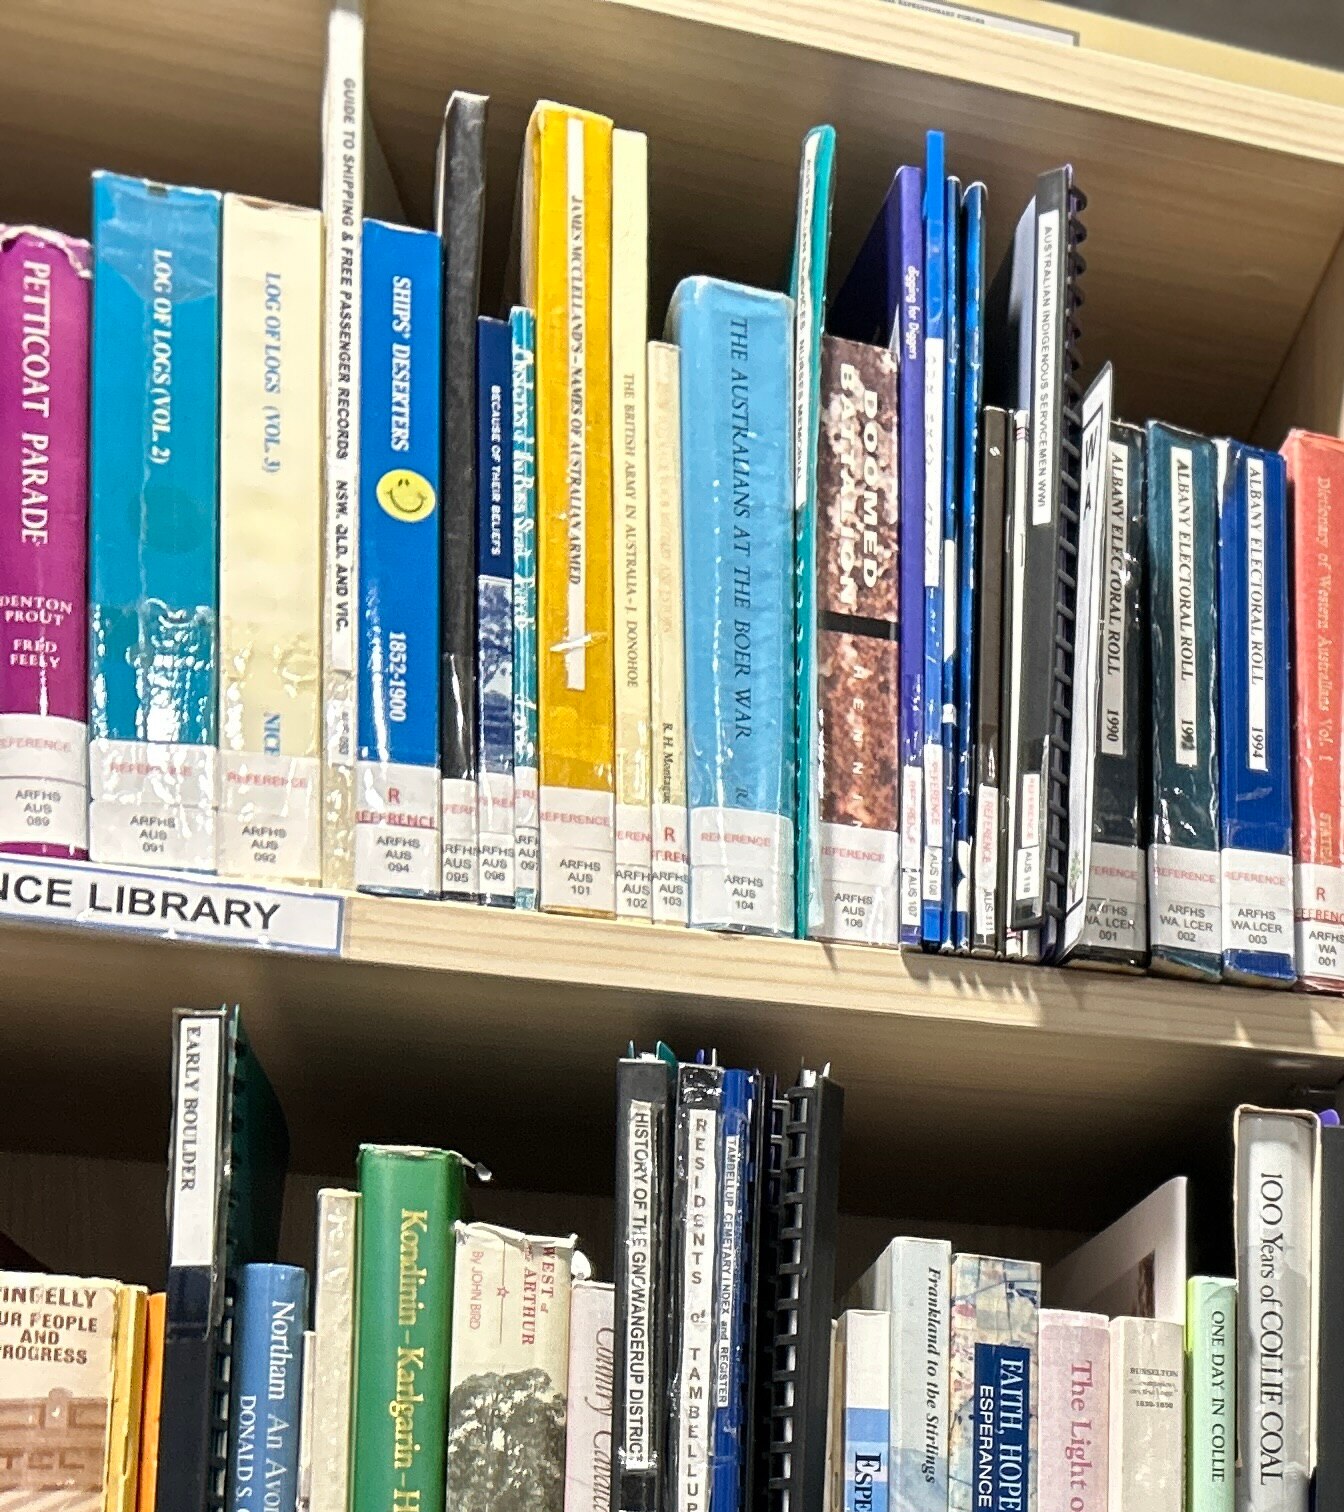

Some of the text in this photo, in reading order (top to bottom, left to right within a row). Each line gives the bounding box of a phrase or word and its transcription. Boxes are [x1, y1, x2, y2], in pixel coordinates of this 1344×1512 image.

[343, 78, 356, 122] GUIDE
[343, 129, 355, 150] TO
[342, 154, 355, 227] SHIPPING
[341, 248, 353, 285] FREE
[342, 232, 353, 244] &
[1042, 225, 1052, 308] AUSTRALIAN
[150, 249, 172, 465] LOG OF LOGS (VOL. 2)
[339, 291, 353, 380] PASSENGER
[1040, 311, 1051, 389] INDIGENOUS
[20, 259, 51, 544] PETTICOAT PARADE
[261, 272, 281, 474] LOG OF LOGS (VOL. 3)
[390, 344, 410, 453] DESERTERS
[337, 383, 350, 460] RECORDS
[1038, 393, 1049, 476] SERVICEMEN
[335, 481, 348, 519] NSW.
[730, 319, 752, 738] THE AUSTRALIANS AT THE BOER WAR
[335, 571, 348, 600] AND
[335, 605, 347, 632] VIC.
[1249, 467, 1265, 758] ALBANY ELECTORAL ROLL 1994
[559, 858, 601, 872] ARFHS
[568, 872, 593, 884] AUS
[571, 884, 591, 896] 101
[89, 882, 281, 930] LIBRARY
[1318, 943, 1337, 955] WA
[1318, 955, 1336, 967] 001
[180, 1026, 202, 1191] EARLY BOULDER
[634, 1112, 649, 1184] HISTORY
[632, 1215, 646, 1247] THE
[633, 1188, 647, 1213] OF
[398, 1208, 428, 1325] Kondinin
[1260, 1232, 1283, 1278] Years
[1261, 1285, 1283, 1308] of
[270, 1301, 294, 1401] Northam
[1068, 1360, 1093, 1412] The
[1260, 1310, 1283, 1407] COLLIE
[266, 1413, 289, 1449] An
[996, 1358, 1024, 1434] FAITH,
[1211, 1310, 1226, 1483] ONE DAY IN COLLIE
[236, 1395, 256, 1481] DONALD
[976, 1385, 994, 1508] ESPERANCE
[1065, 1419, 1093, 1490] Light
[1259, 1412, 1283, 1485] COAL
[236, 1486, 253, 1502] S.
[998, 1443, 1022, 1512] HOPE
